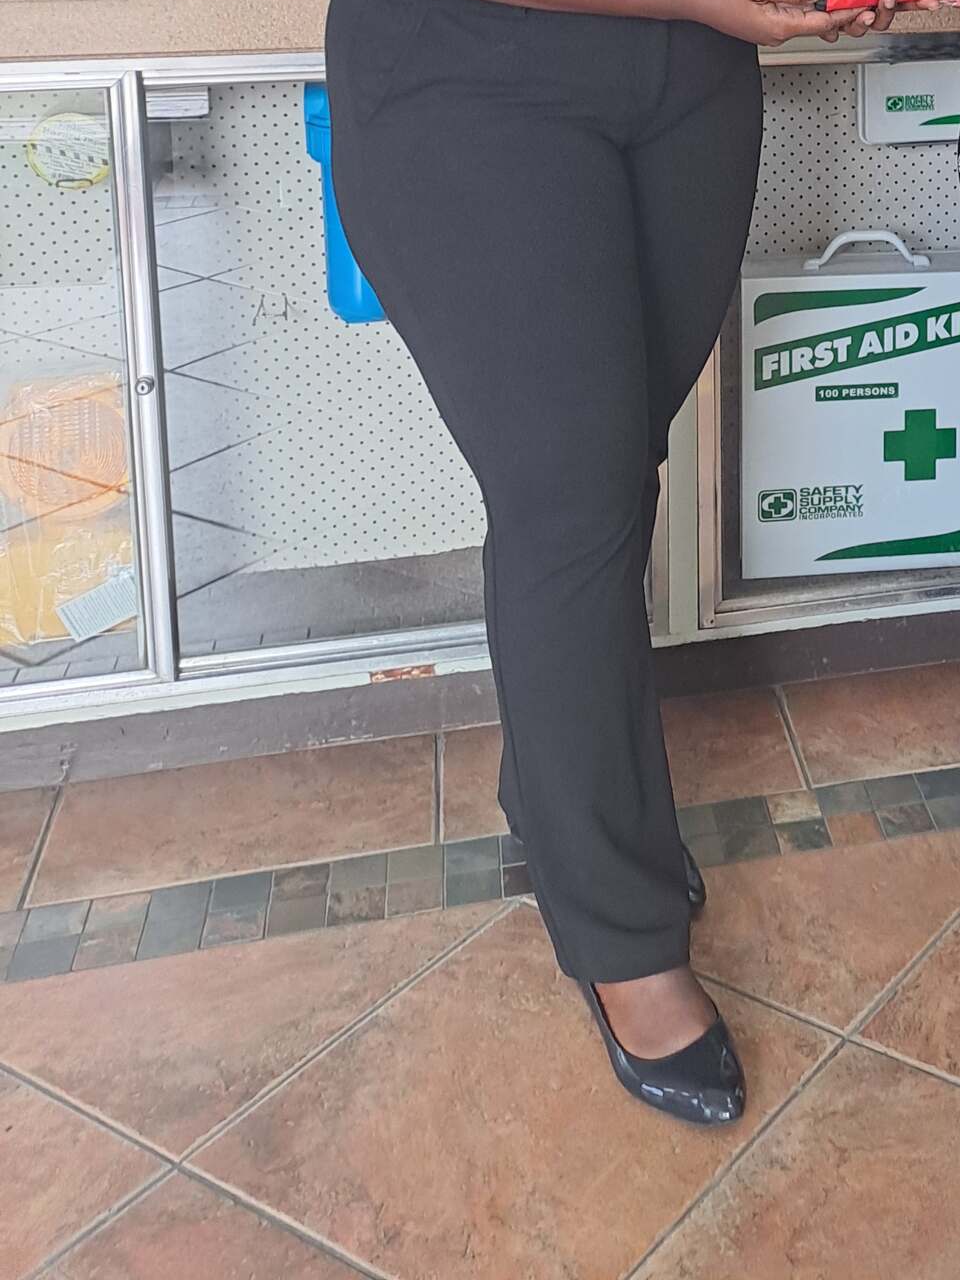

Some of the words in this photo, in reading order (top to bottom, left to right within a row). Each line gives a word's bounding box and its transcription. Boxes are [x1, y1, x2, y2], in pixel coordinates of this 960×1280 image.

[761, 335, 853, 381] FIRST
[857, 322, 920, 360] AID
[819, 389, 839, 399] 100
[842, 386, 896, 398] PERSONS
[799, 484, 864, 497] SAFETY
[799, 494, 864, 507] SUPPLY
[798, 504, 864, 515] COMPANY
[798, 511, 864, 521] INCORPORATED
